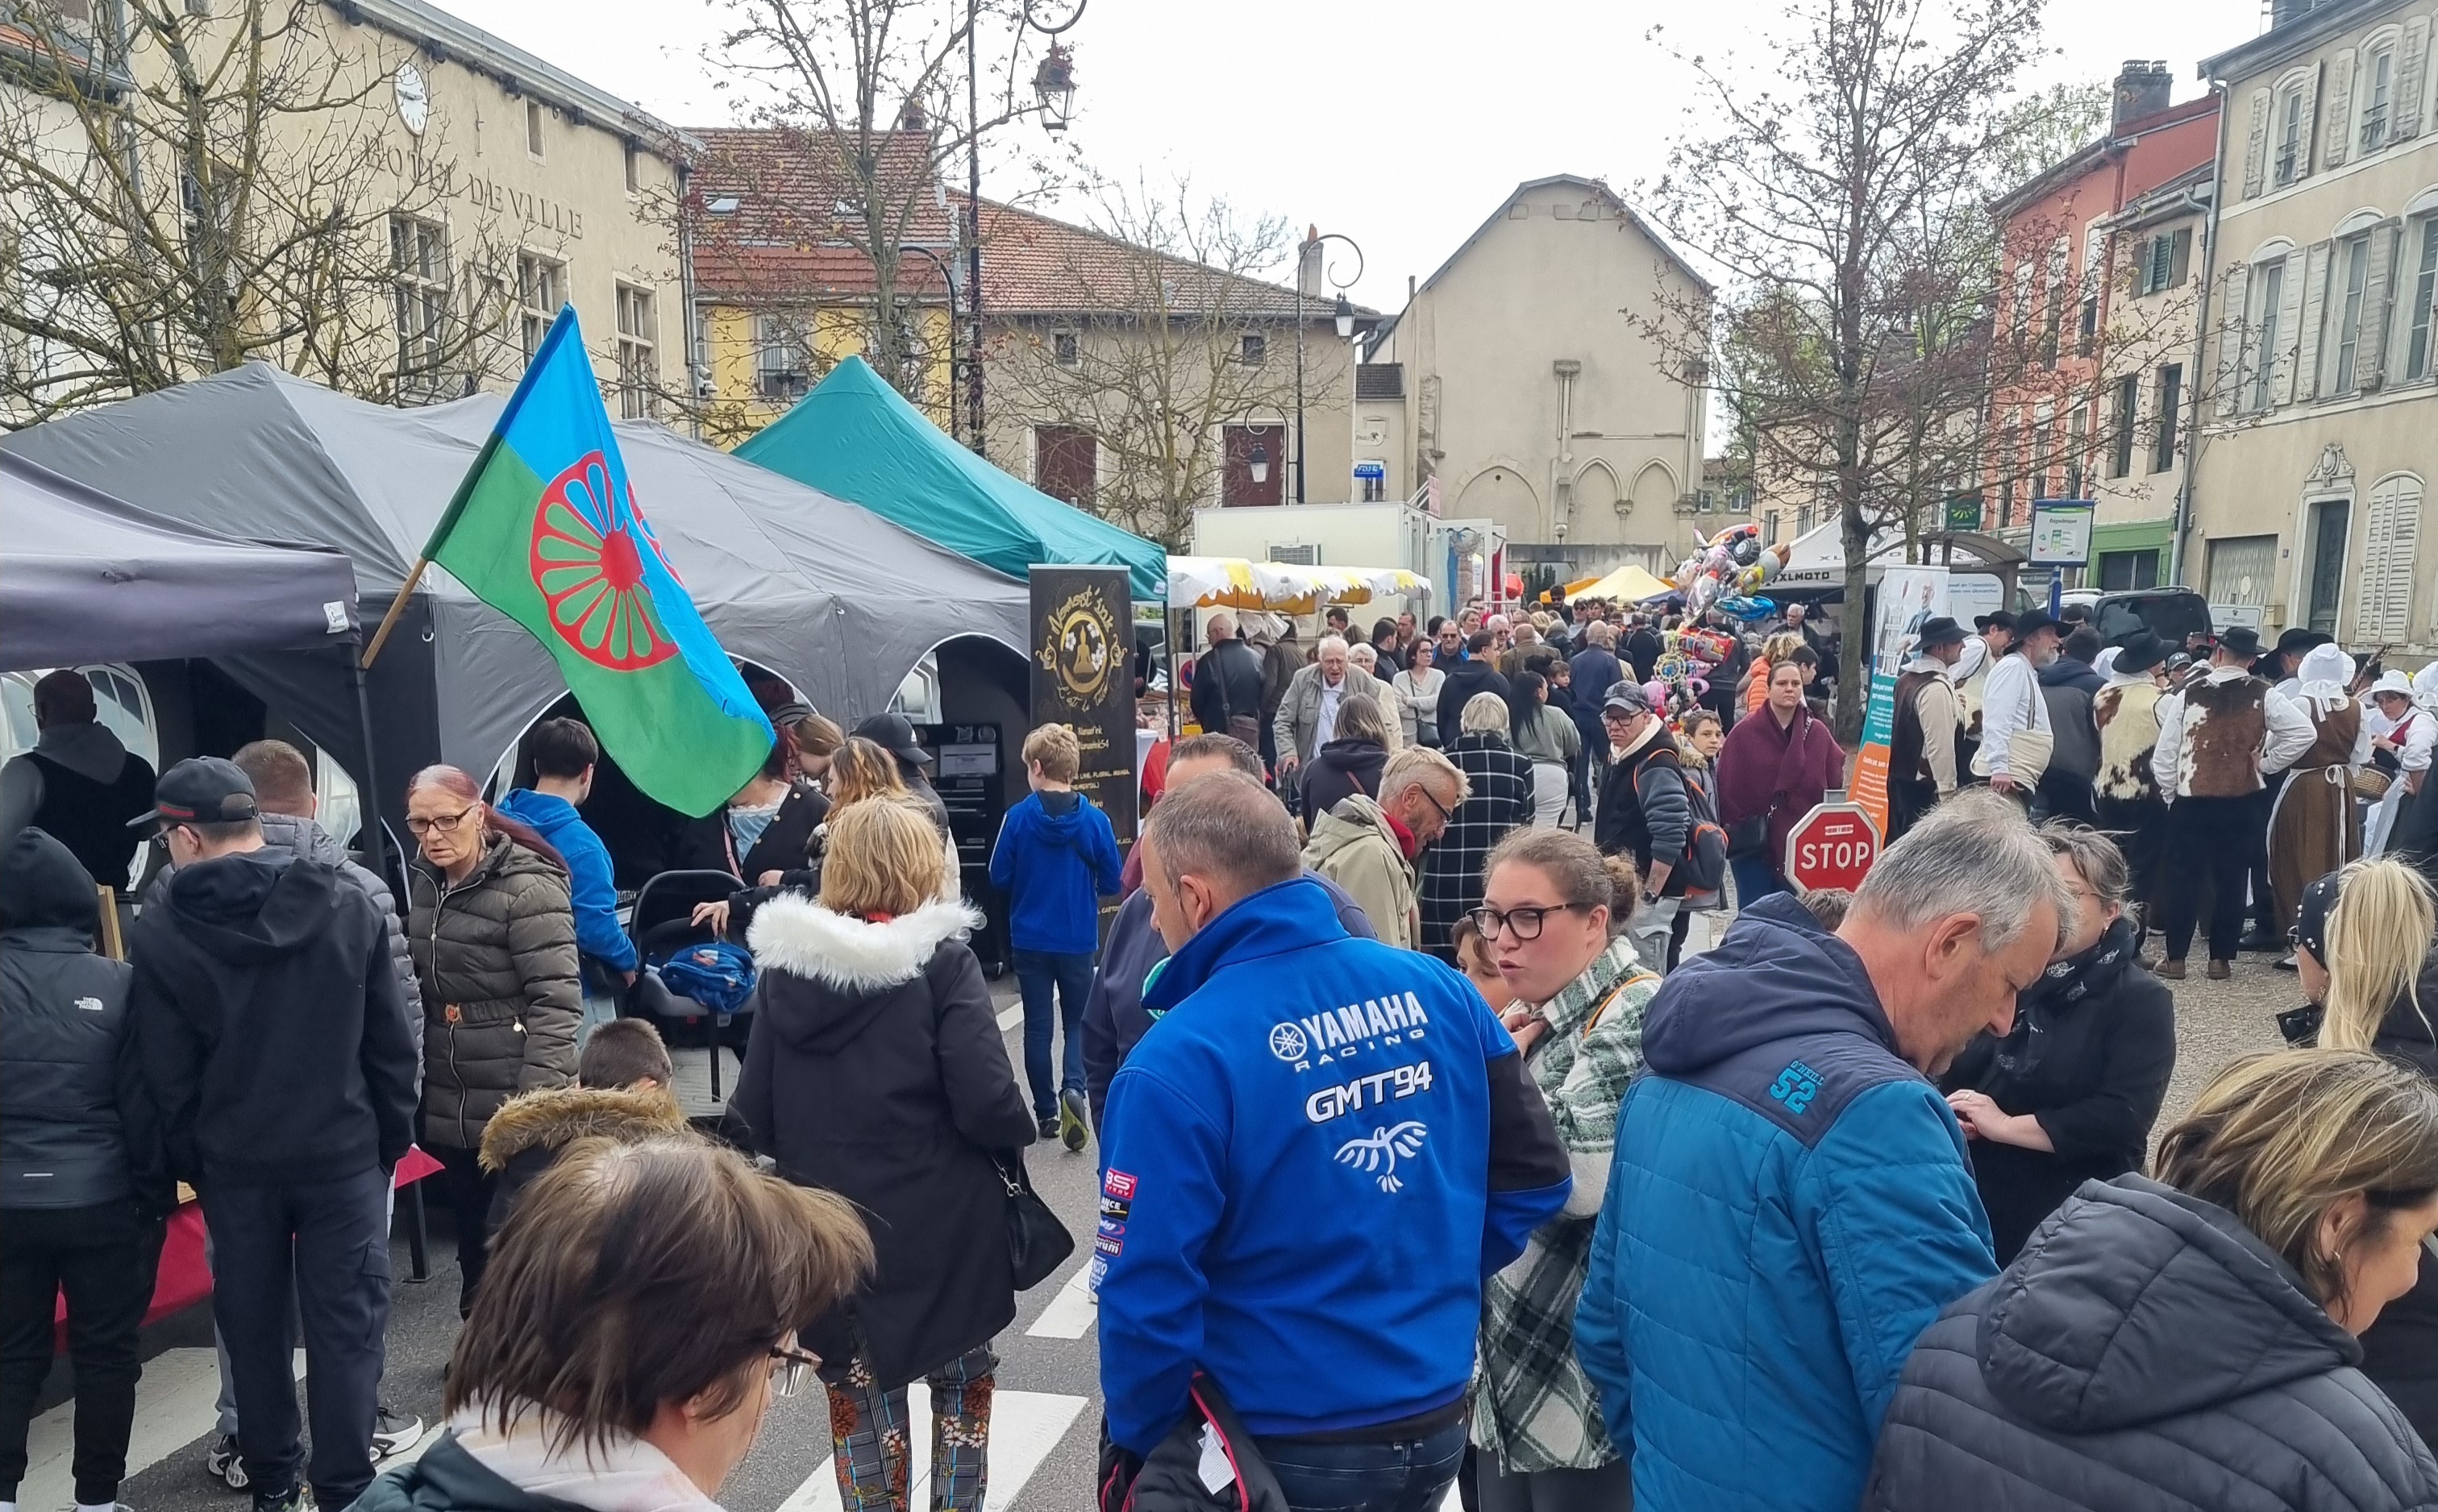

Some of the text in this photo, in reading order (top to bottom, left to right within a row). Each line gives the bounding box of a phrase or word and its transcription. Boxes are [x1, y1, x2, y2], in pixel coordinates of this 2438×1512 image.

[468, 172, 503, 213] DE
[508, 187, 584, 239] VILLE
[1779, 571, 1830, 582] XLMOTO
[1800, 841, 1870, 870] STOP
[1301, 991, 1429, 1051] YAMAHA
[1295, 1028, 1425, 1073] RACING
[1305, 1061, 1433, 1124] GMT94
[1770, 1067, 1816, 1115] 52
